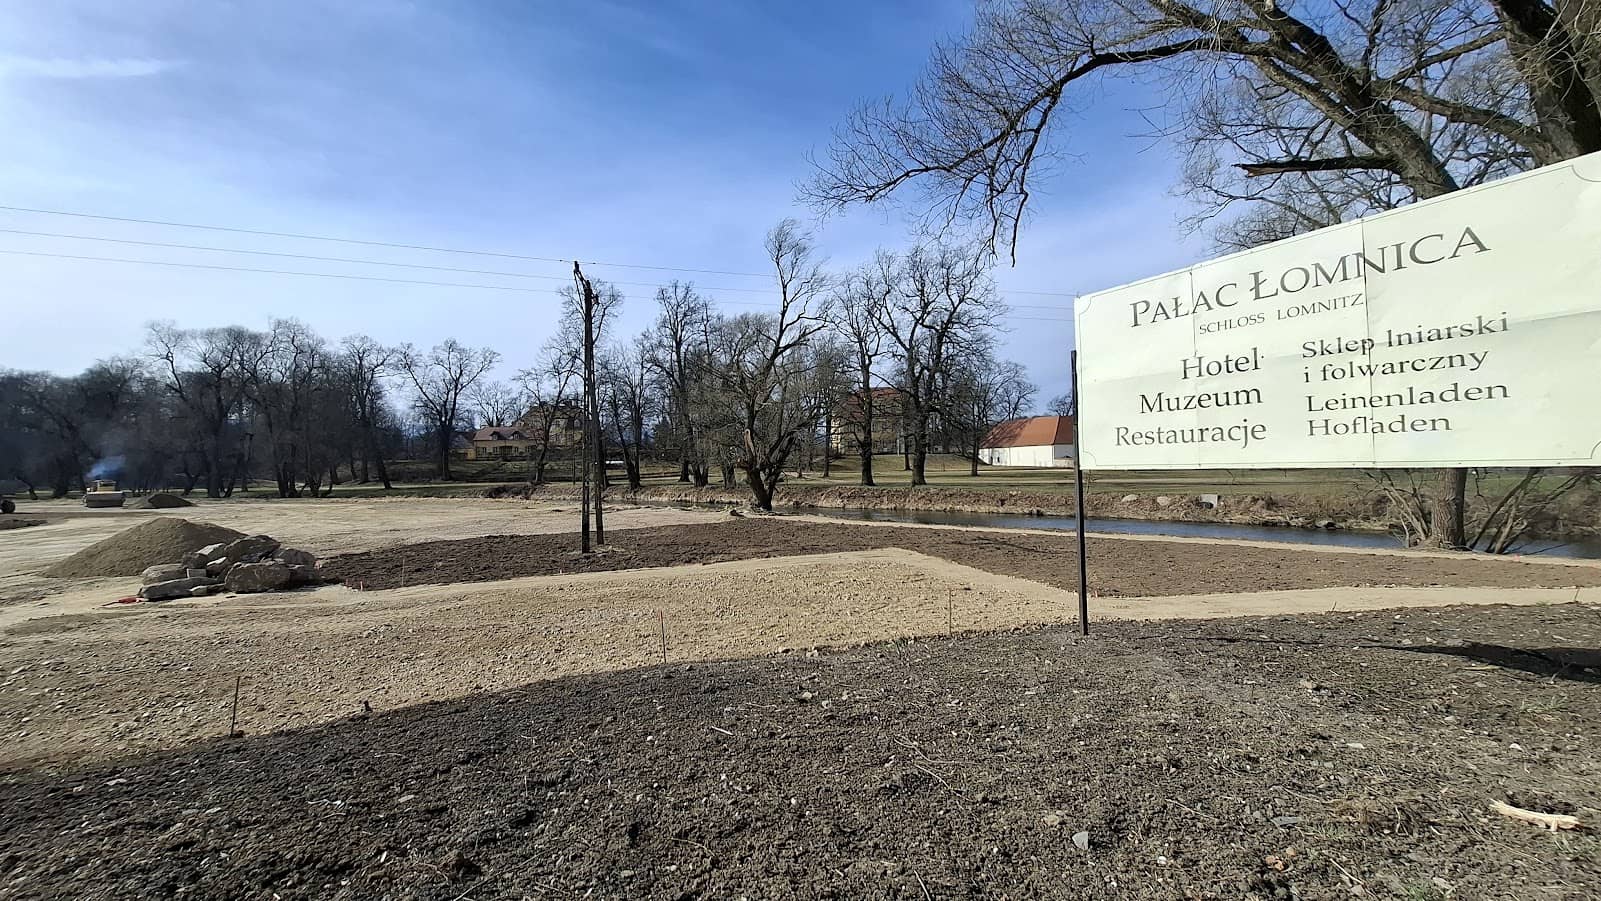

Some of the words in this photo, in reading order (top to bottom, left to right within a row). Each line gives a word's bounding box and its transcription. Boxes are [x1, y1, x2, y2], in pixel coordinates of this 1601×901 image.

[1129, 283, 1238, 328] PAŁAC
[1249, 226, 1491, 301] ŁOMNICA
[1199, 312, 1266, 336] SCHLOSS
[1277, 293, 1364, 321] LOMNITZ
[1302, 337, 1375, 359] Sklep
[1181, 348, 1261, 381] Hotel
[1303, 366, 1310, 383] i
[1320, 350, 1489, 381] folwarczny
[1139, 385, 1262, 415] Muzeum
[1306, 382, 1511, 413] Leinenladen
[1115, 419, 1267, 449] Restauracje
[1307, 414, 1453, 437] Hofladen
